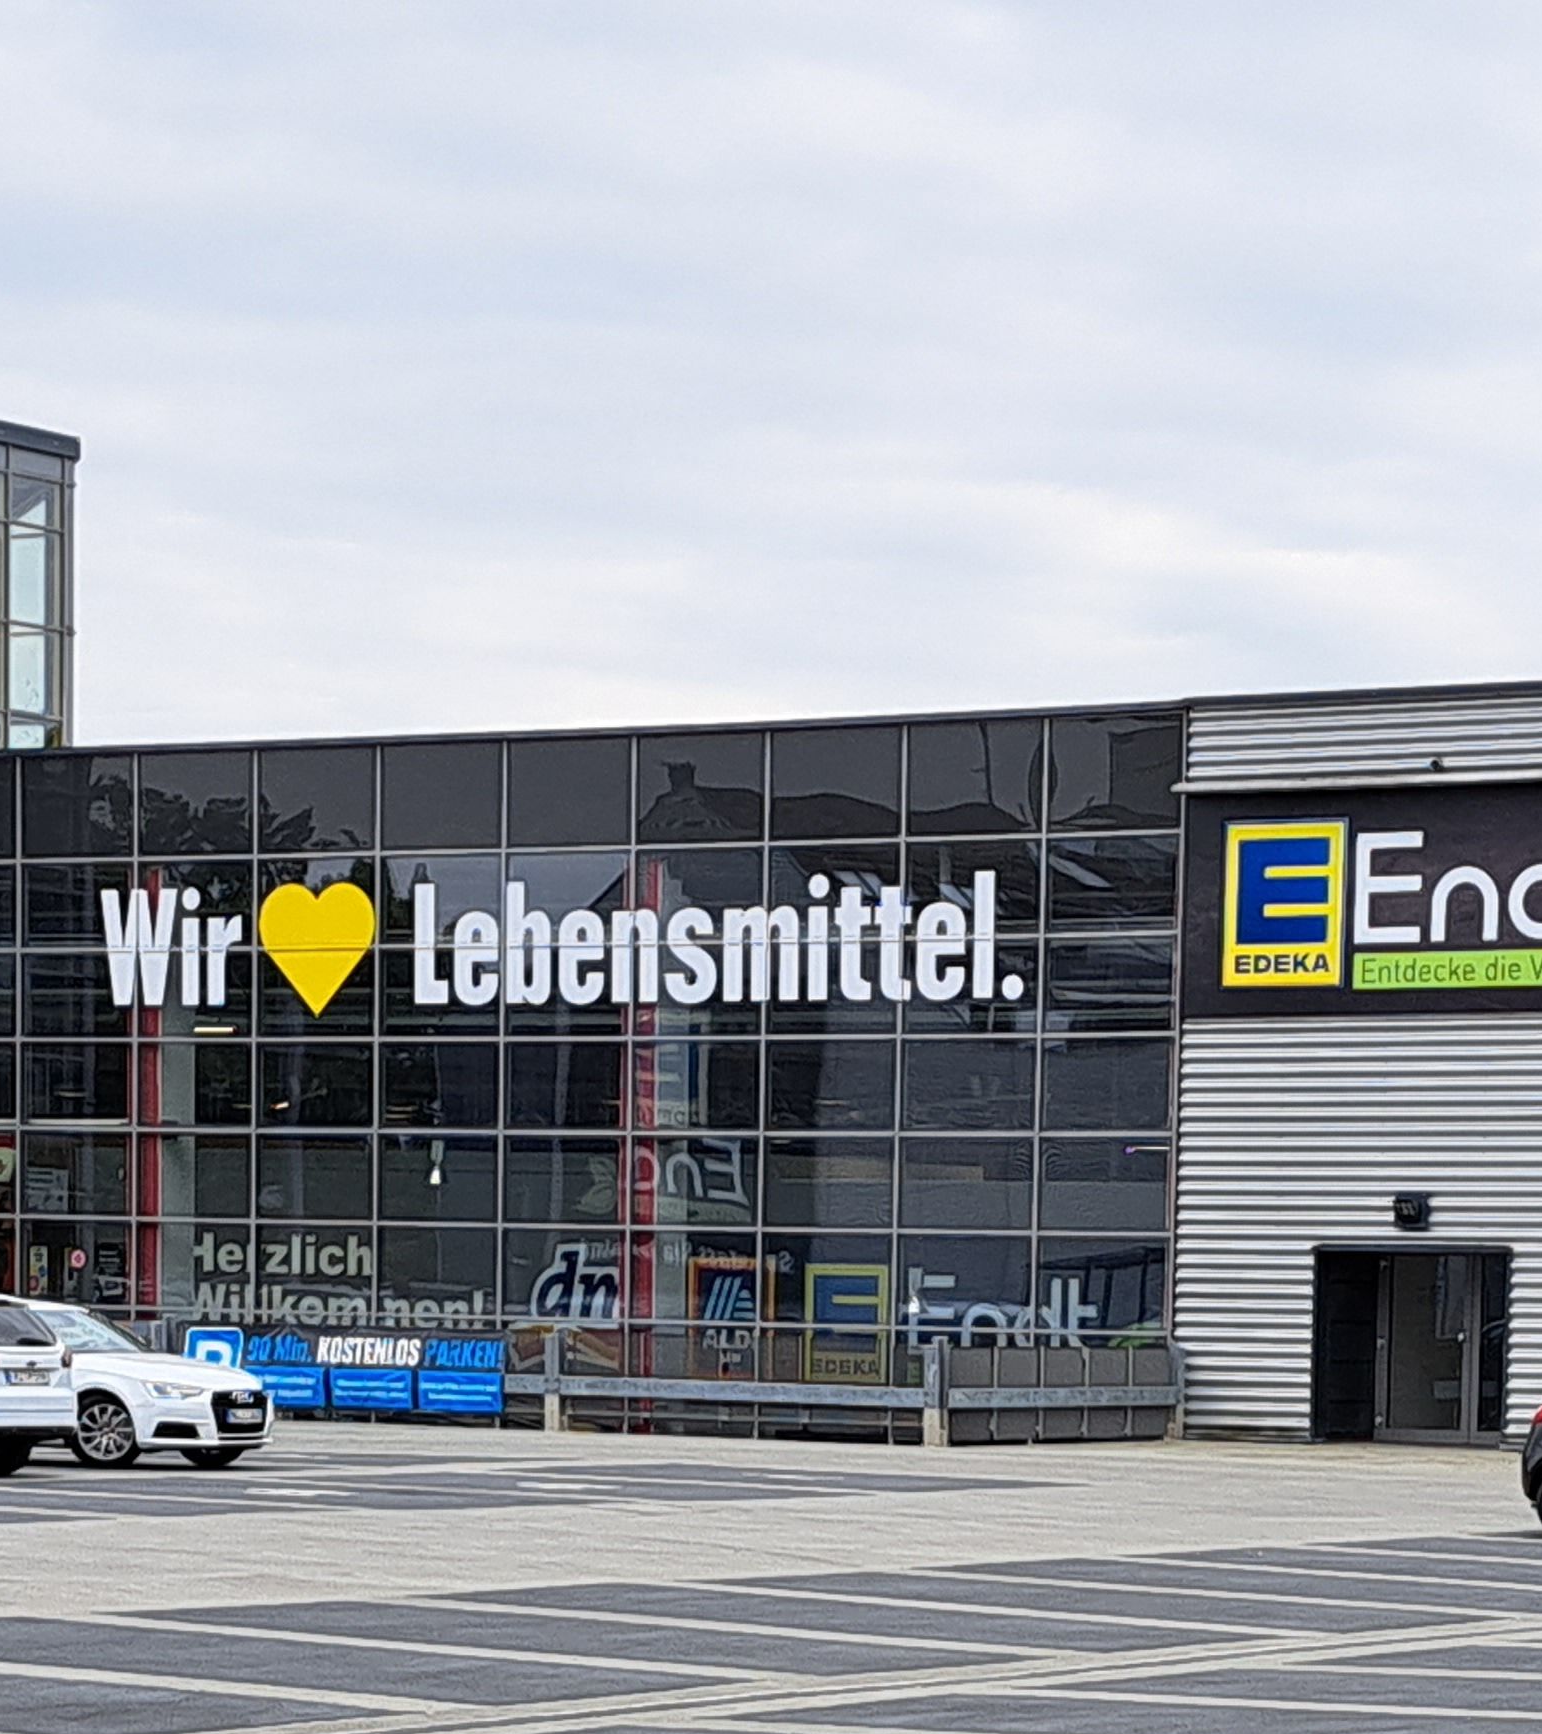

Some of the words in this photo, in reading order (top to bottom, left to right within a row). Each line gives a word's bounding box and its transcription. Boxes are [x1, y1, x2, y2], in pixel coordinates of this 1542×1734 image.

[1235, 836, 1330, 945] E
[100, 887, 243, 1007] Wir
[412, 869, 1025, 1005] Lebensmittel.
[1234, 953, 1330, 975] EDEKA
[1360, 957, 1476, 985] Entdecke
[1484, 958, 1522, 982] die
[192, 1231, 373, 1277] Herzlich
[316, 1336, 422, 1367] KOSTENLOS
[424, 1338, 505, 1368] PARKEN!
